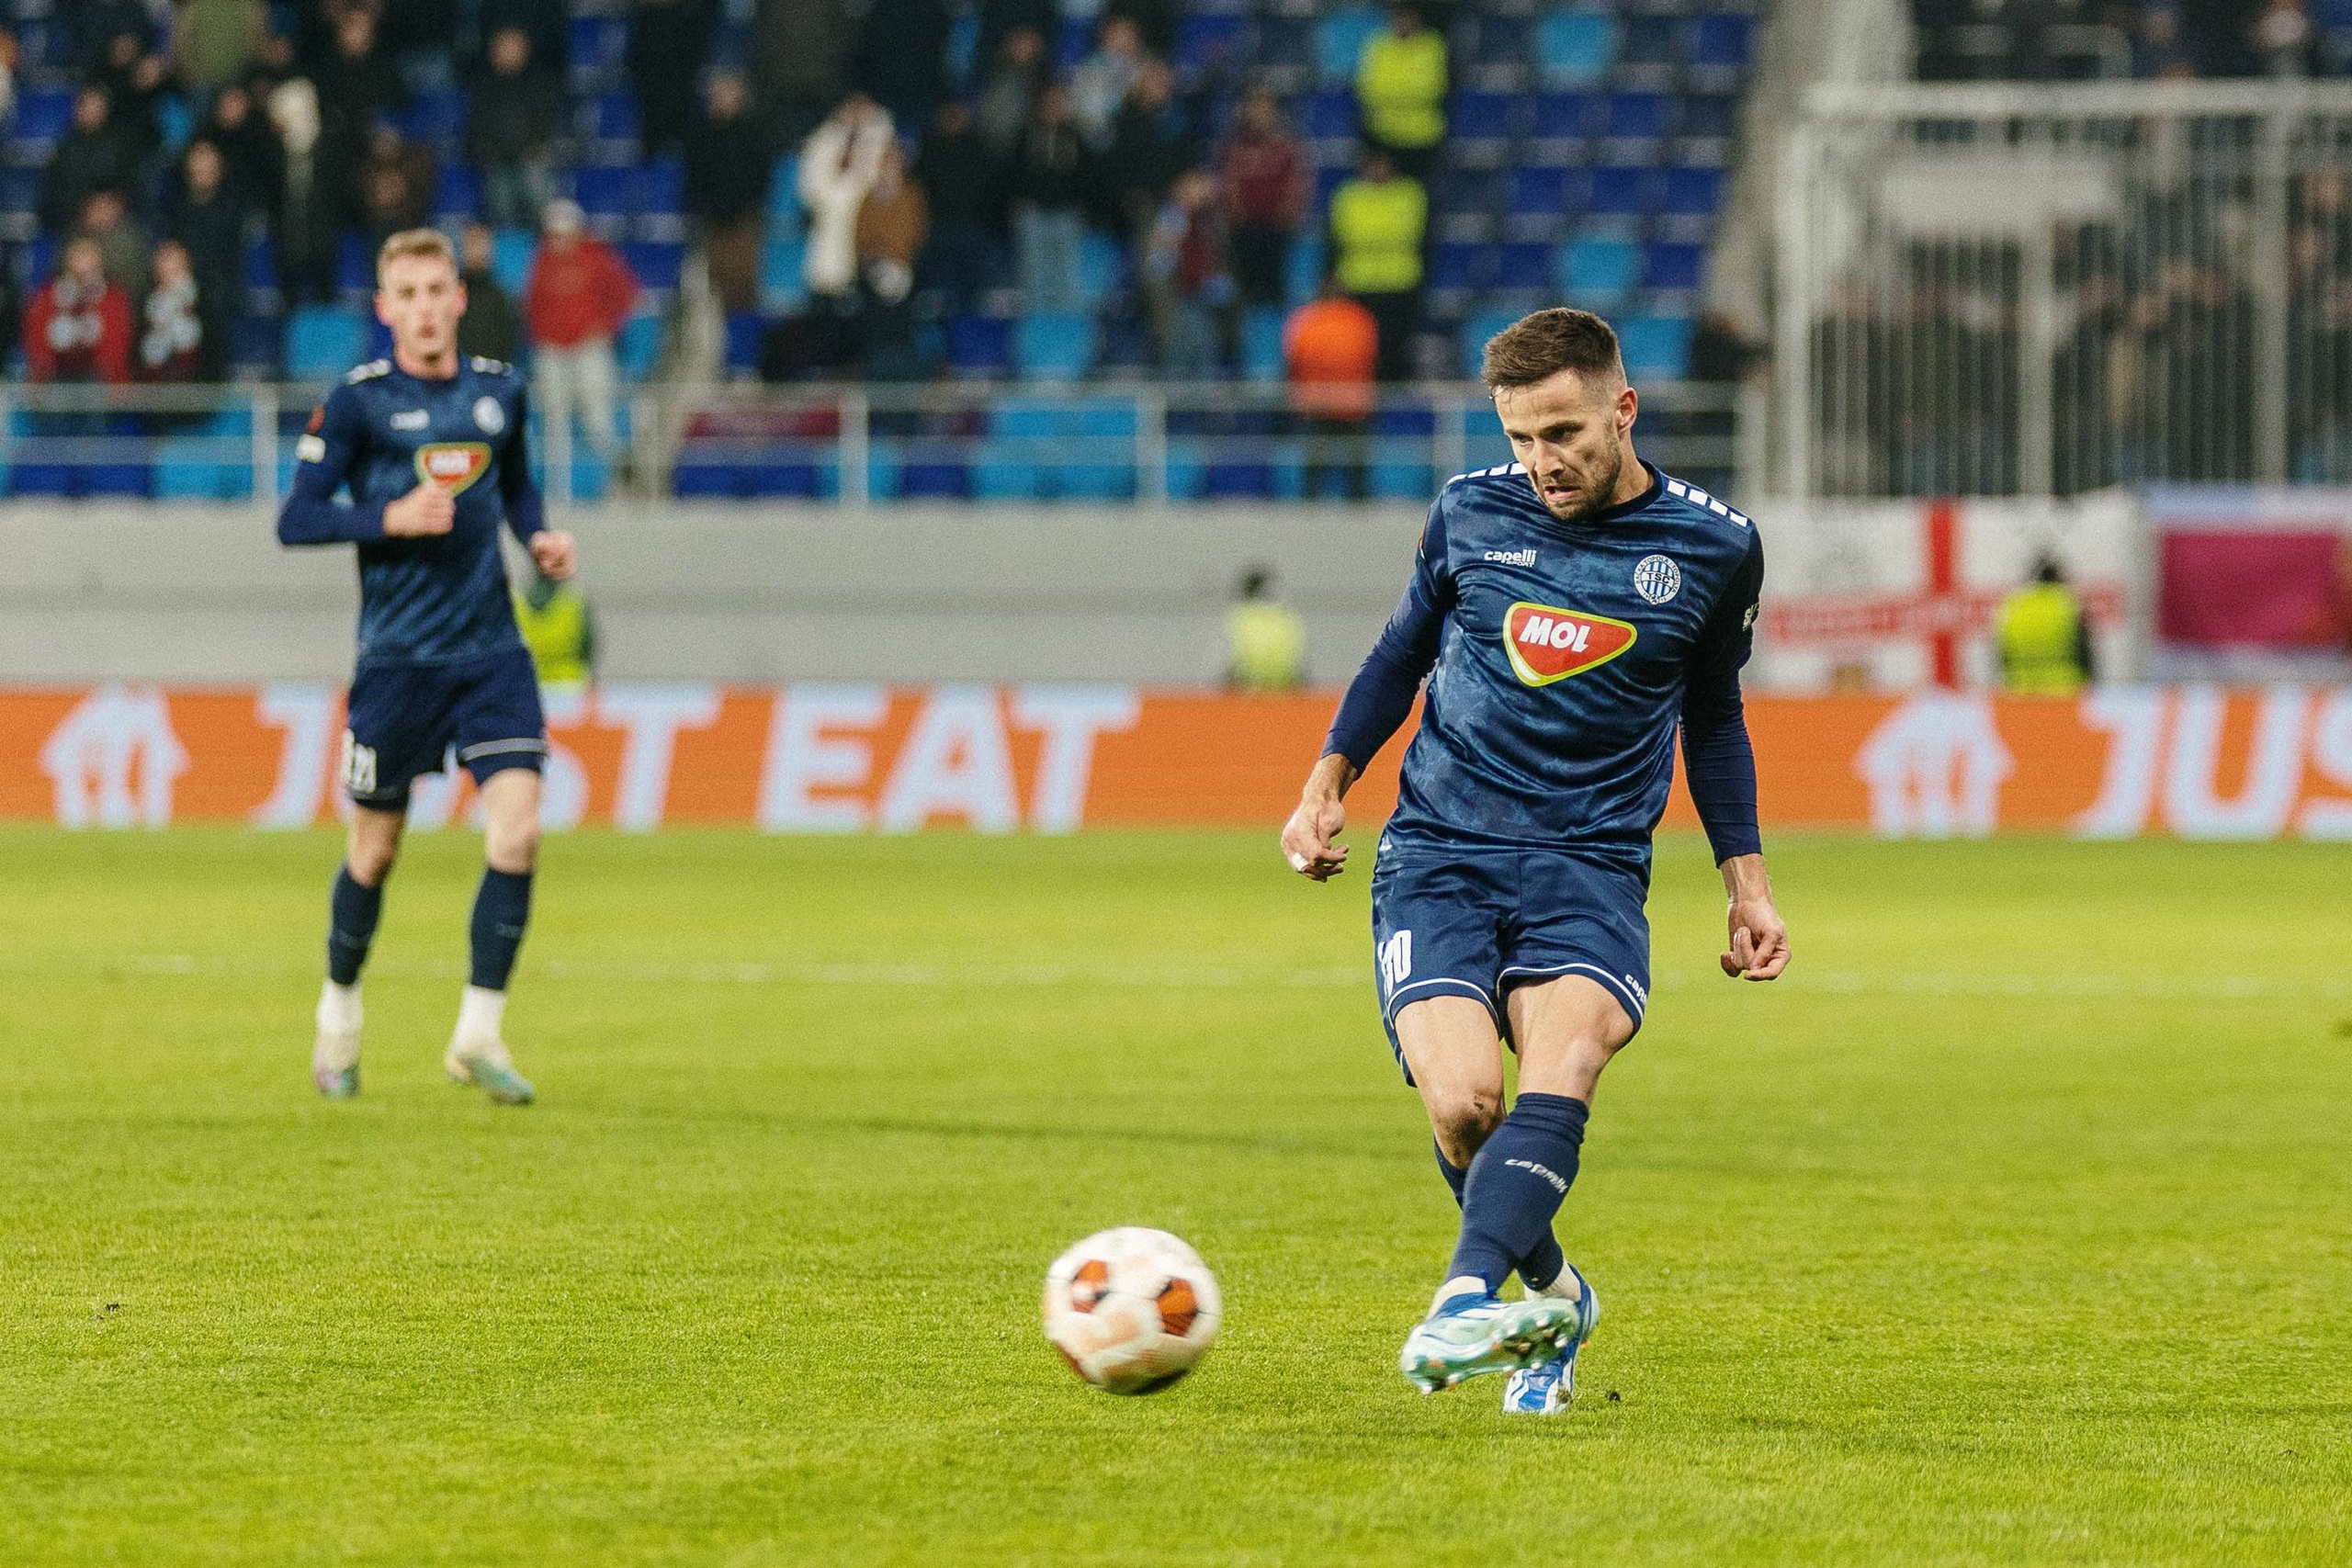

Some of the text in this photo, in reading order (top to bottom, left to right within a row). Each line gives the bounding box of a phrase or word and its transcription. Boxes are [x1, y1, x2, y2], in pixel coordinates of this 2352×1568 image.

[1484, 548, 1537, 564] capelli
[1646, 572, 1670, 584] TSC
[1518, 615, 1591, 653] MOL
[756, 683, 1143, 835] EAT
